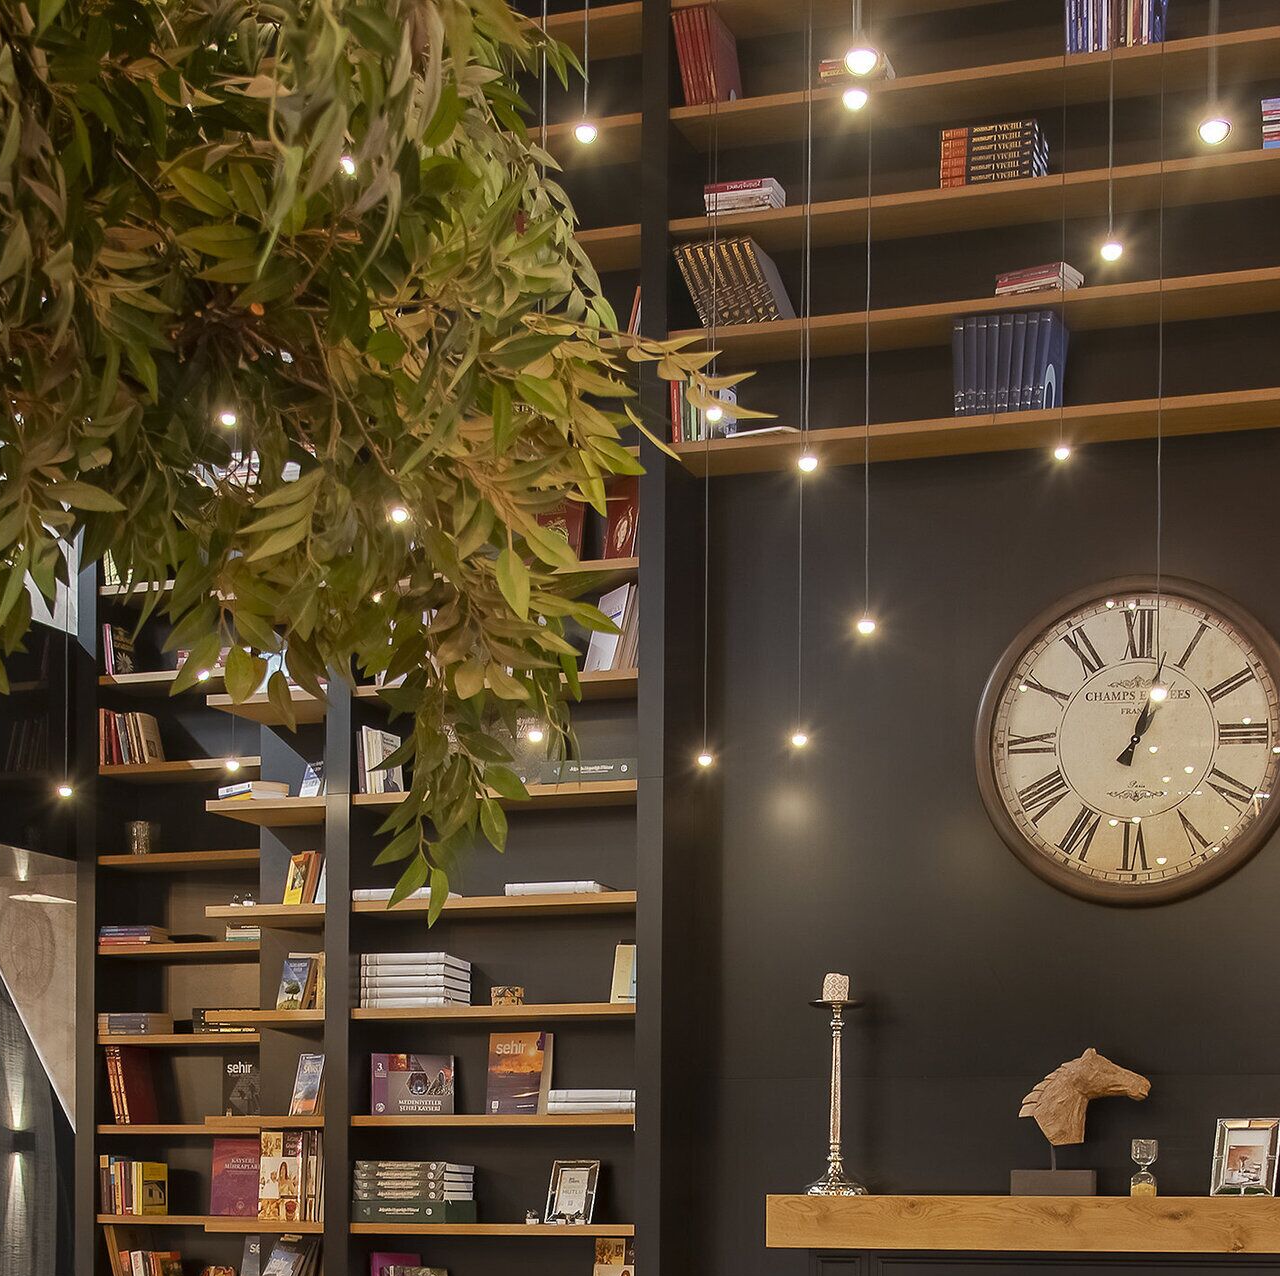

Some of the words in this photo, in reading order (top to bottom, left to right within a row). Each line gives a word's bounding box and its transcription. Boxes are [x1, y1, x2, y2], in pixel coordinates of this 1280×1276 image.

[1120, 608, 1158, 660] XII
[1174, 620, 1212, 671] I
[1085, 691, 1136, 701] CHAMPS
[1140, 690, 1191, 700] EEES
[1203, 662, 1258, 708] II
[1217, 719, 1269, 749] III
[1177, 808, 1213, 856] V
